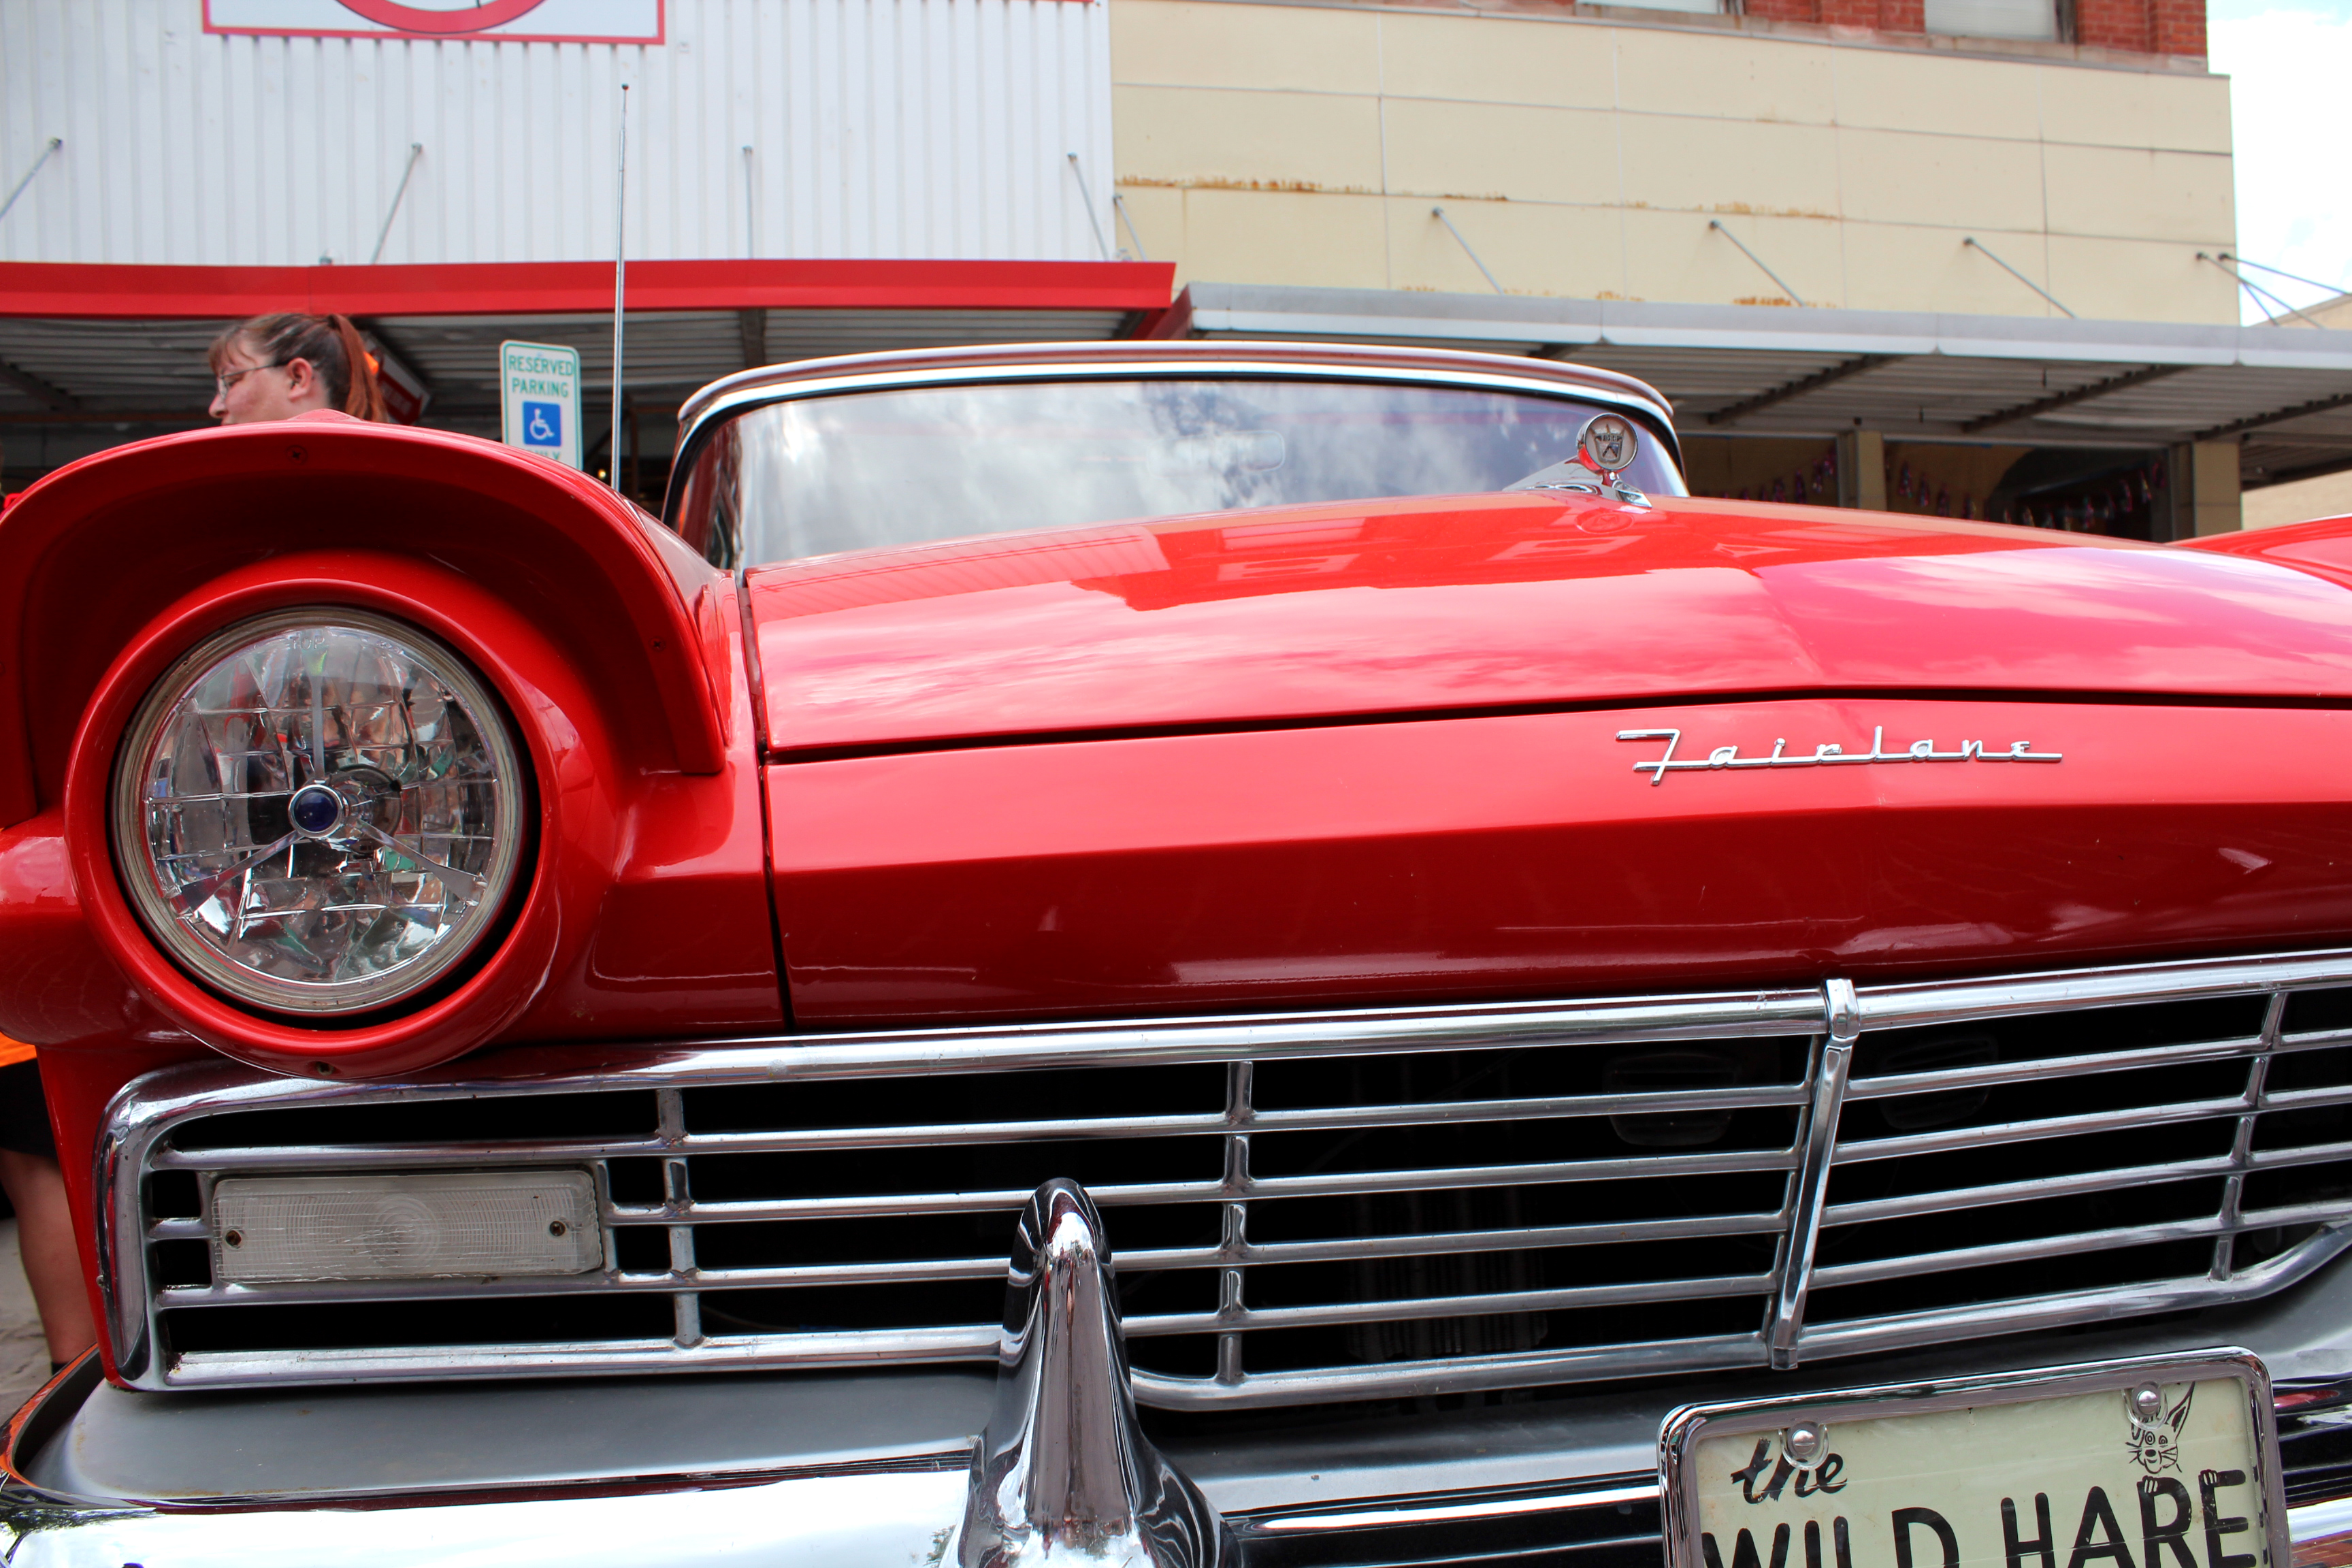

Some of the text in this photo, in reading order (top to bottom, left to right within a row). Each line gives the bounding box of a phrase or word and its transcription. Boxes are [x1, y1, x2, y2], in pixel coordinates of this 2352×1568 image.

[508, 355, 574, 376] RESERVED
[512, 378, 568, 397] PARKING
[1616, 725, 2063, 785] Fairlane
[1731, 1437, 1848, 1504] the
[2001, 1469, 2257, 1568] HARE
